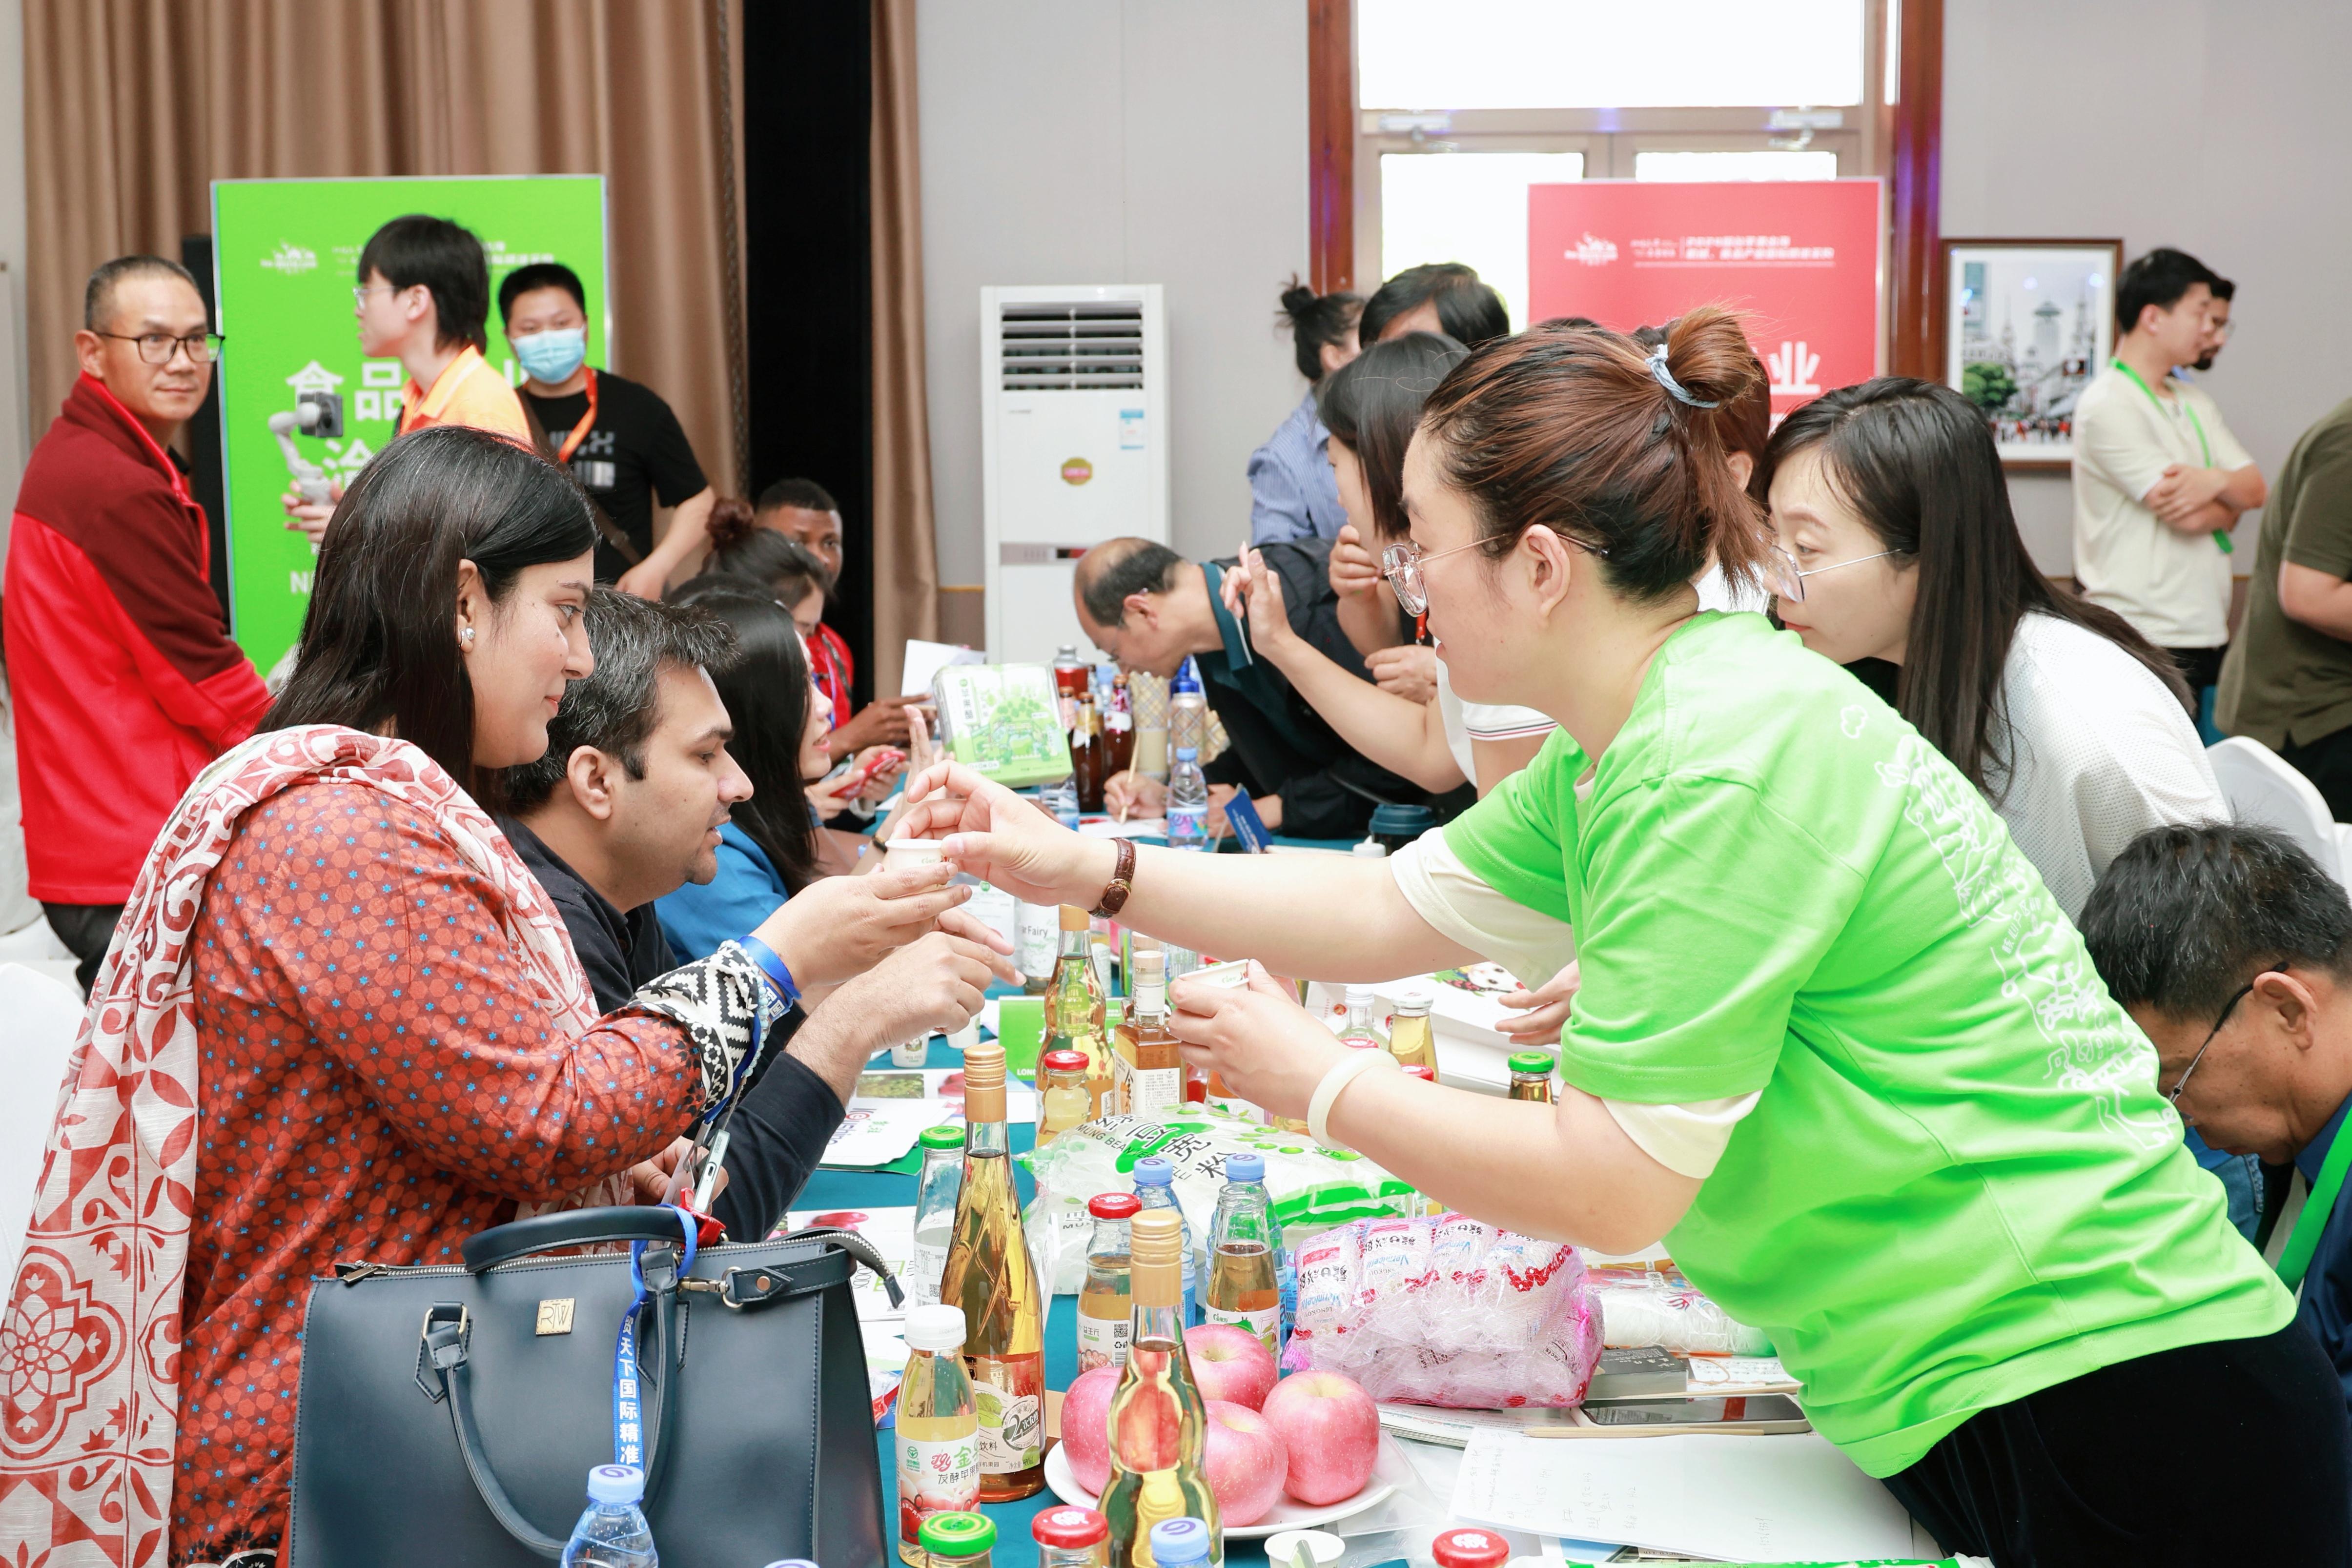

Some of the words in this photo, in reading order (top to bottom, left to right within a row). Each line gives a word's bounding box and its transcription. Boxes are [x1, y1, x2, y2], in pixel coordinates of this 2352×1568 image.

[1076, 1124, 1106, 1140] MUNG
[1104, 1137, 1132, 1154] BEAN
[938, 1464, 979, 1485] 发酵苹果
